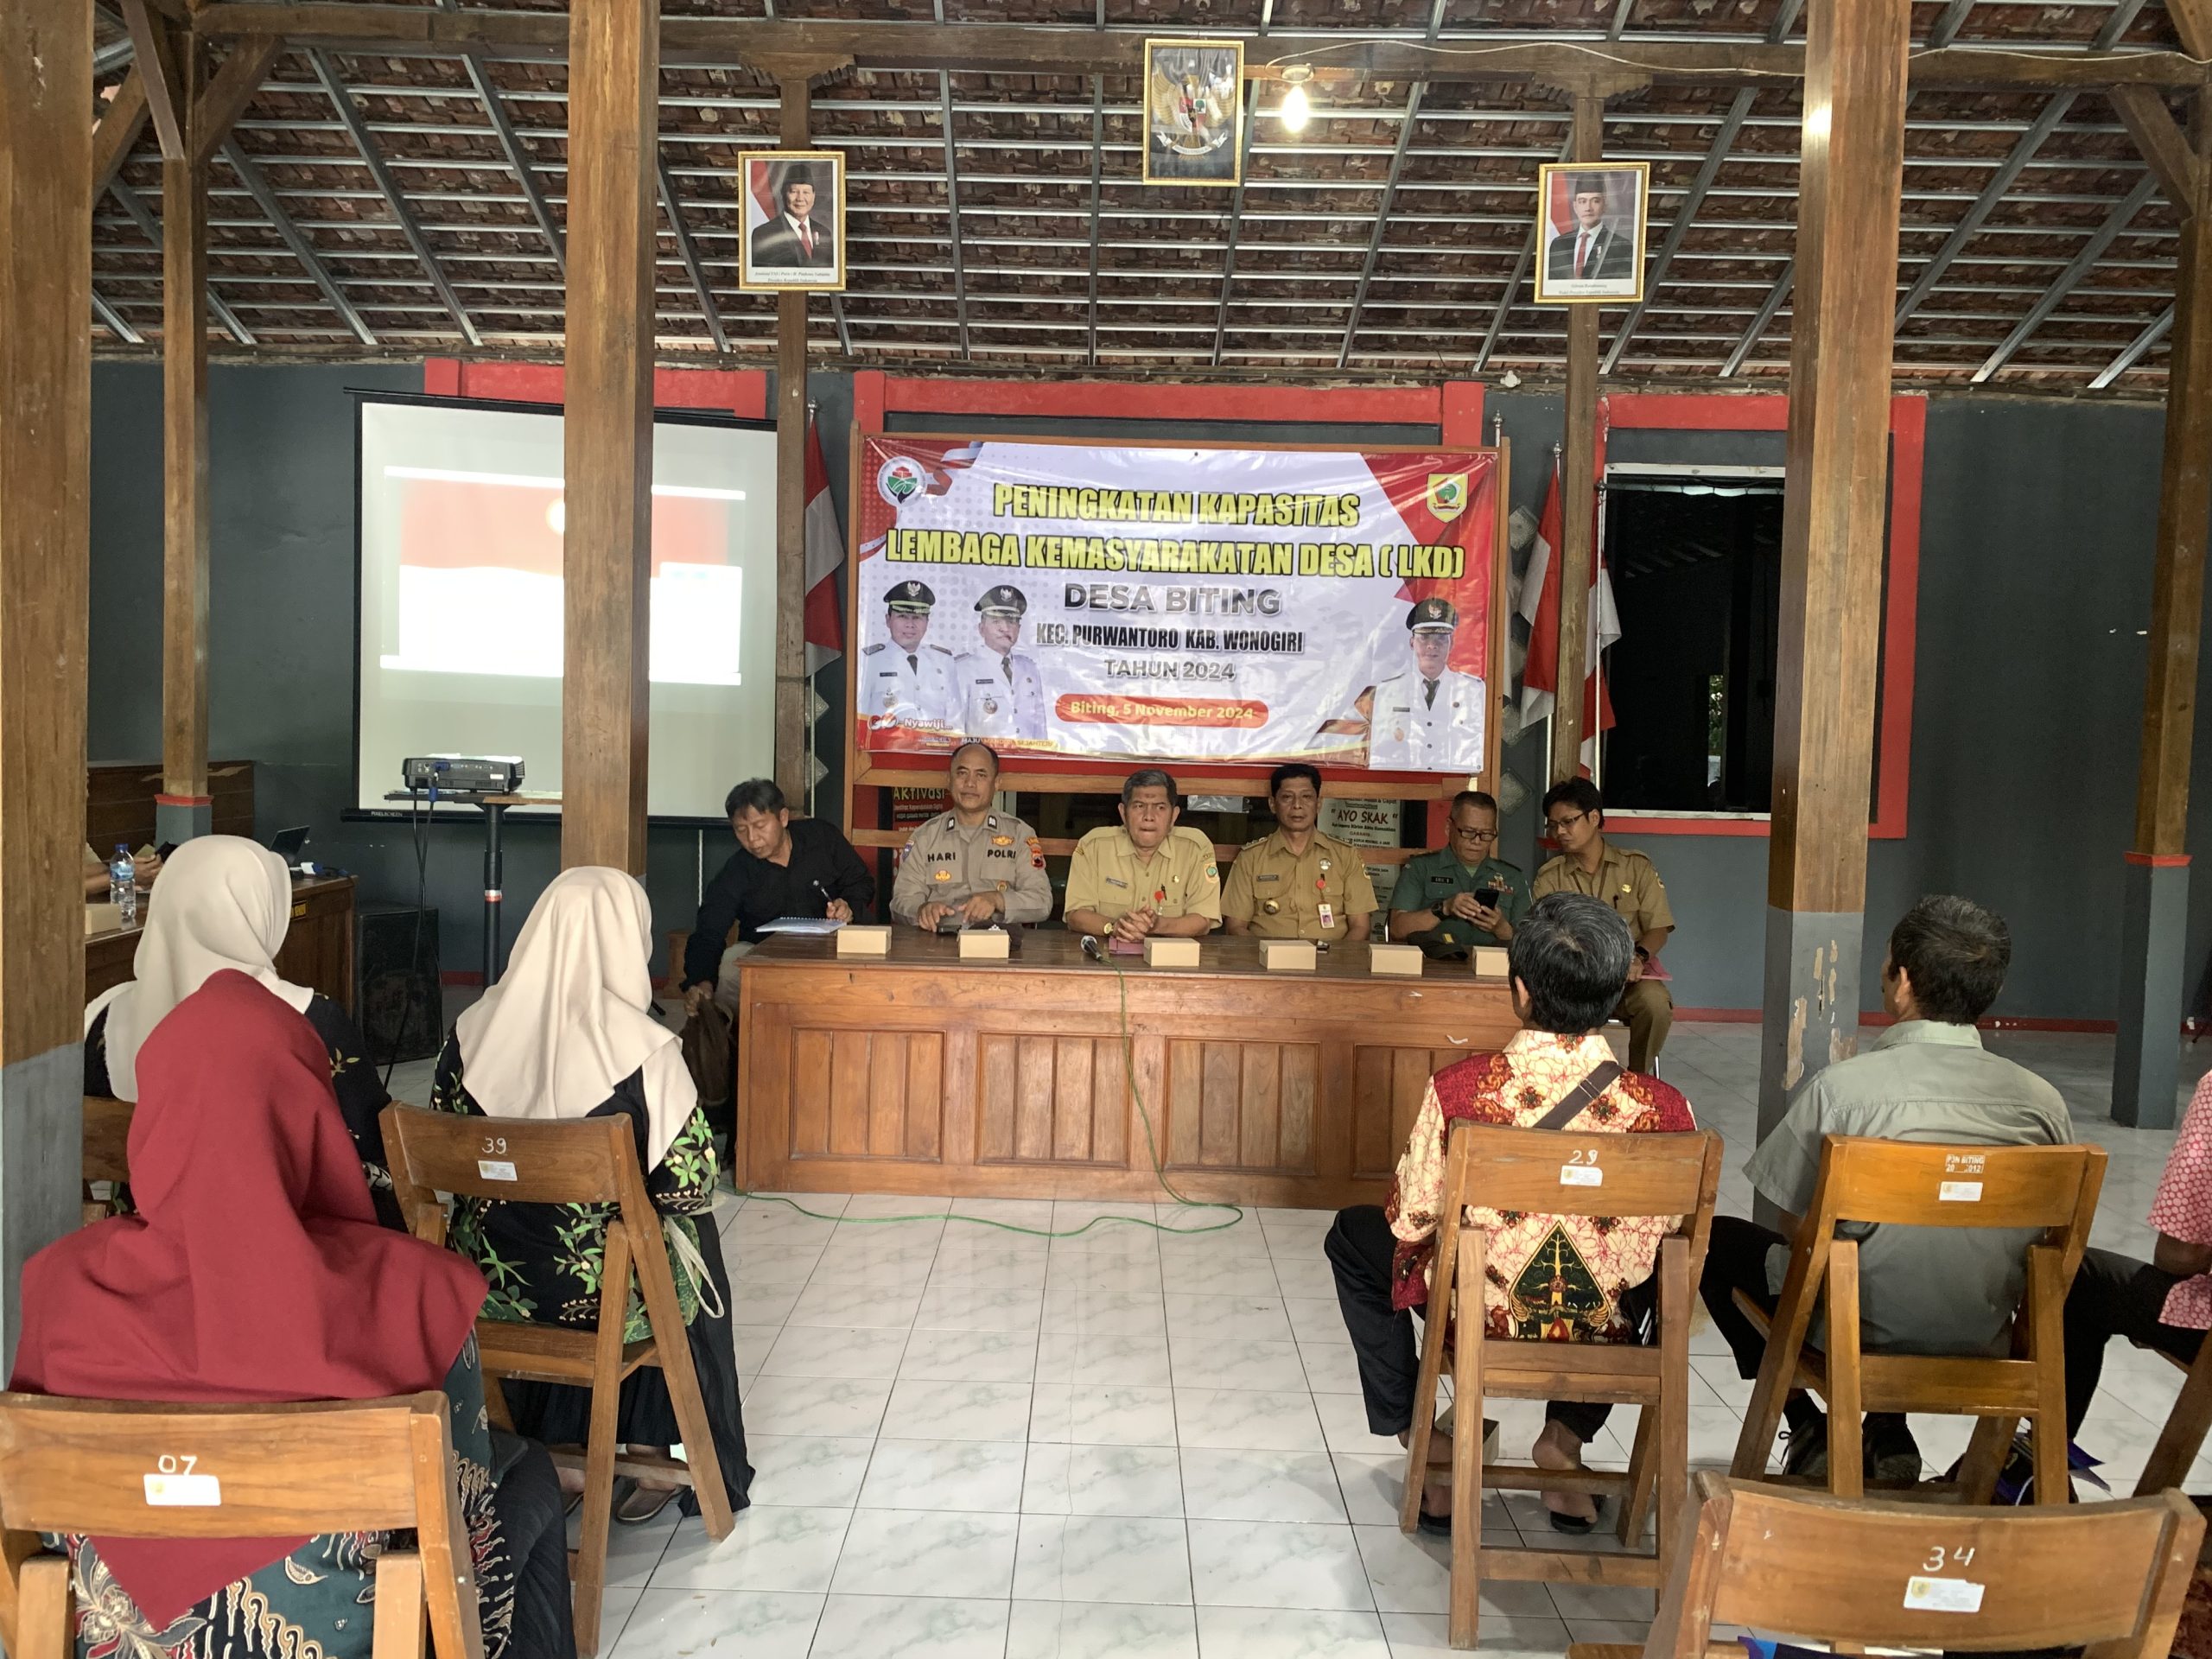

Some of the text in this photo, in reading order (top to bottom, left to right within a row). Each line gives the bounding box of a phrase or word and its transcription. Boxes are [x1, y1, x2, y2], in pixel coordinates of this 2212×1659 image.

[994, 483, 1361, 527] PENINGKATAN KAPASITAS
[886, 529, 1021, 567] LEMBAGA
[1025, 534, 1294, 575] KEMASYARAKATAN
[1298, 543, 1375, 578] DESA
[1064, 582, 1281, 615] DESA BITING
[1036, 622, 1304, 652] KEC. PURWANTORO KAB. WONOGIRI
[1103, 658, 1236, 680] TAHUN 2024
[1071, 701, 1254, 720] Biting, 5 November 2024
[1337, 810, 1358, 822] AYO
[1361, 810, 1389, 824] SKAK
[927, 852, 956, 862] HARI
[987, 849, 1017, 859] POLRI
[481, 1135, 507, 1155] 39
[1568, 1149, 1599, 1166] 29
[158, 1454, 198, 1476] 07
[1923, 1546, 1975, 1572] 34
